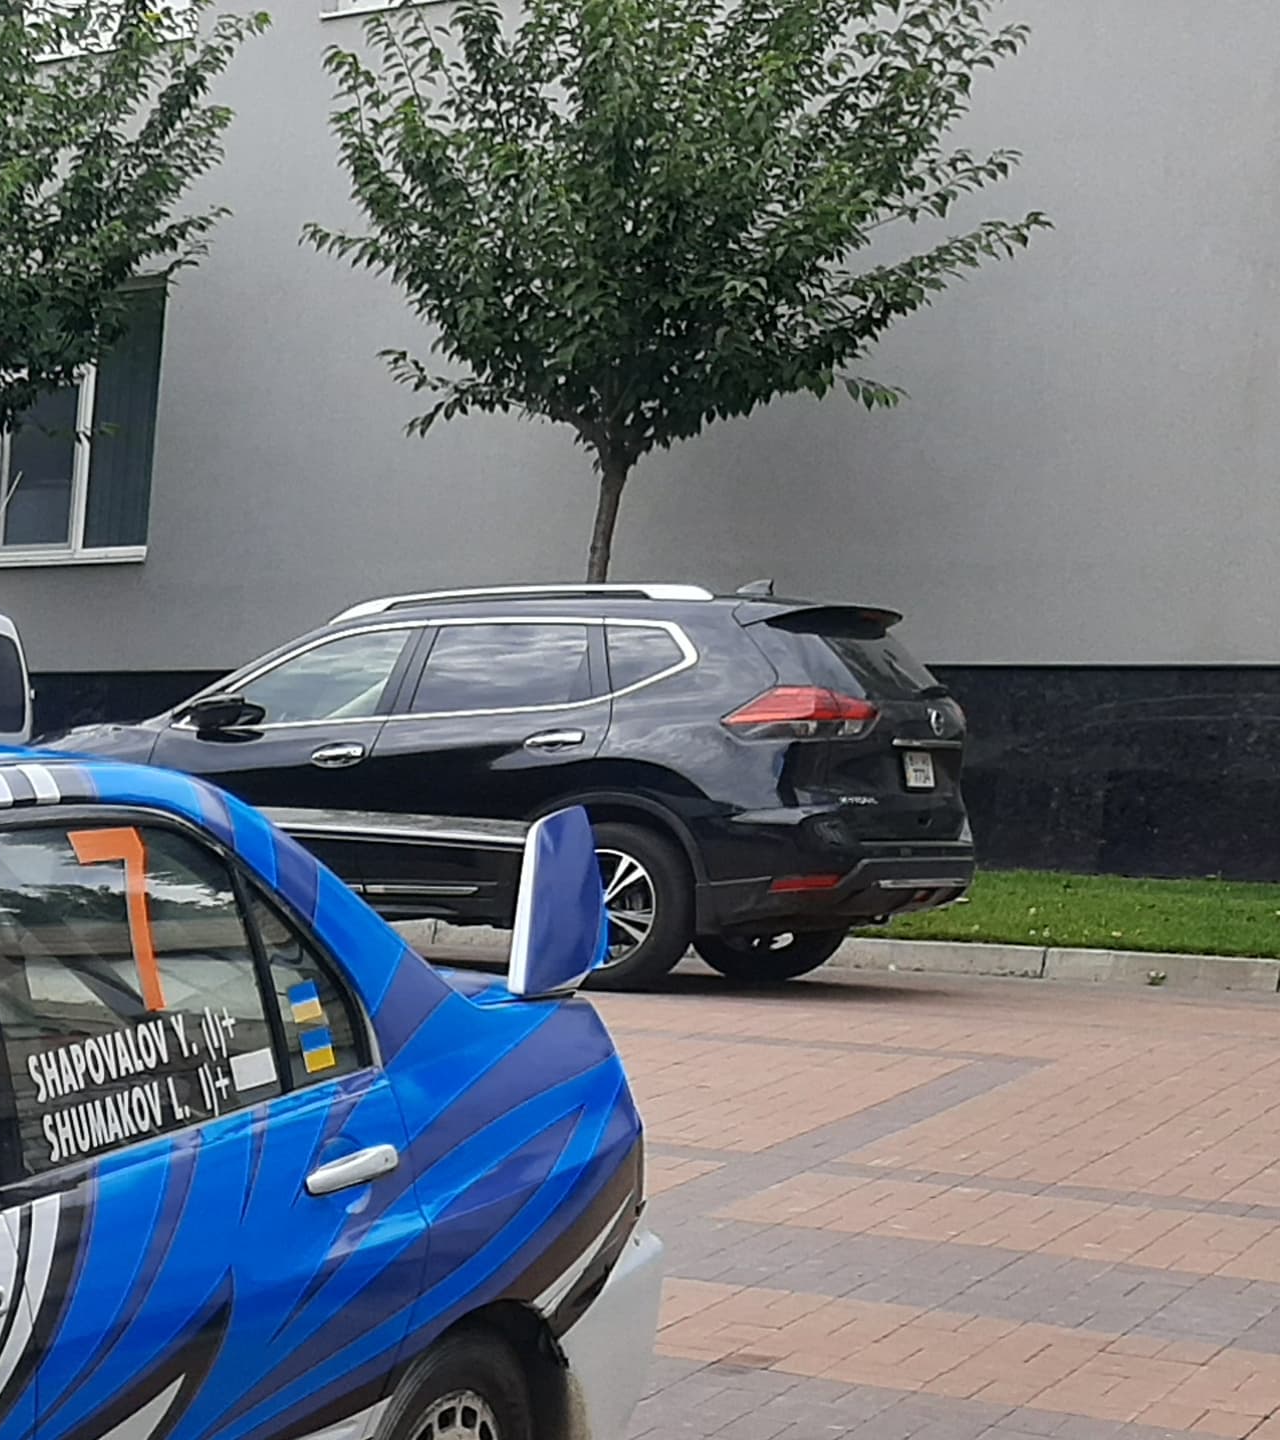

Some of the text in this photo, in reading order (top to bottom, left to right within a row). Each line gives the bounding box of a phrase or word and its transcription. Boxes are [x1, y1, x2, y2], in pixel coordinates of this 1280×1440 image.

[65, 826, 166, 1011] 7
[28, 1018, 168, 1103] SHAPOVALOV
[170, 1014, 198, 1058] Y.
[42, 1080, 162, 1163] SHUMAKOV
[166, 1077, 191, 1121] L.
